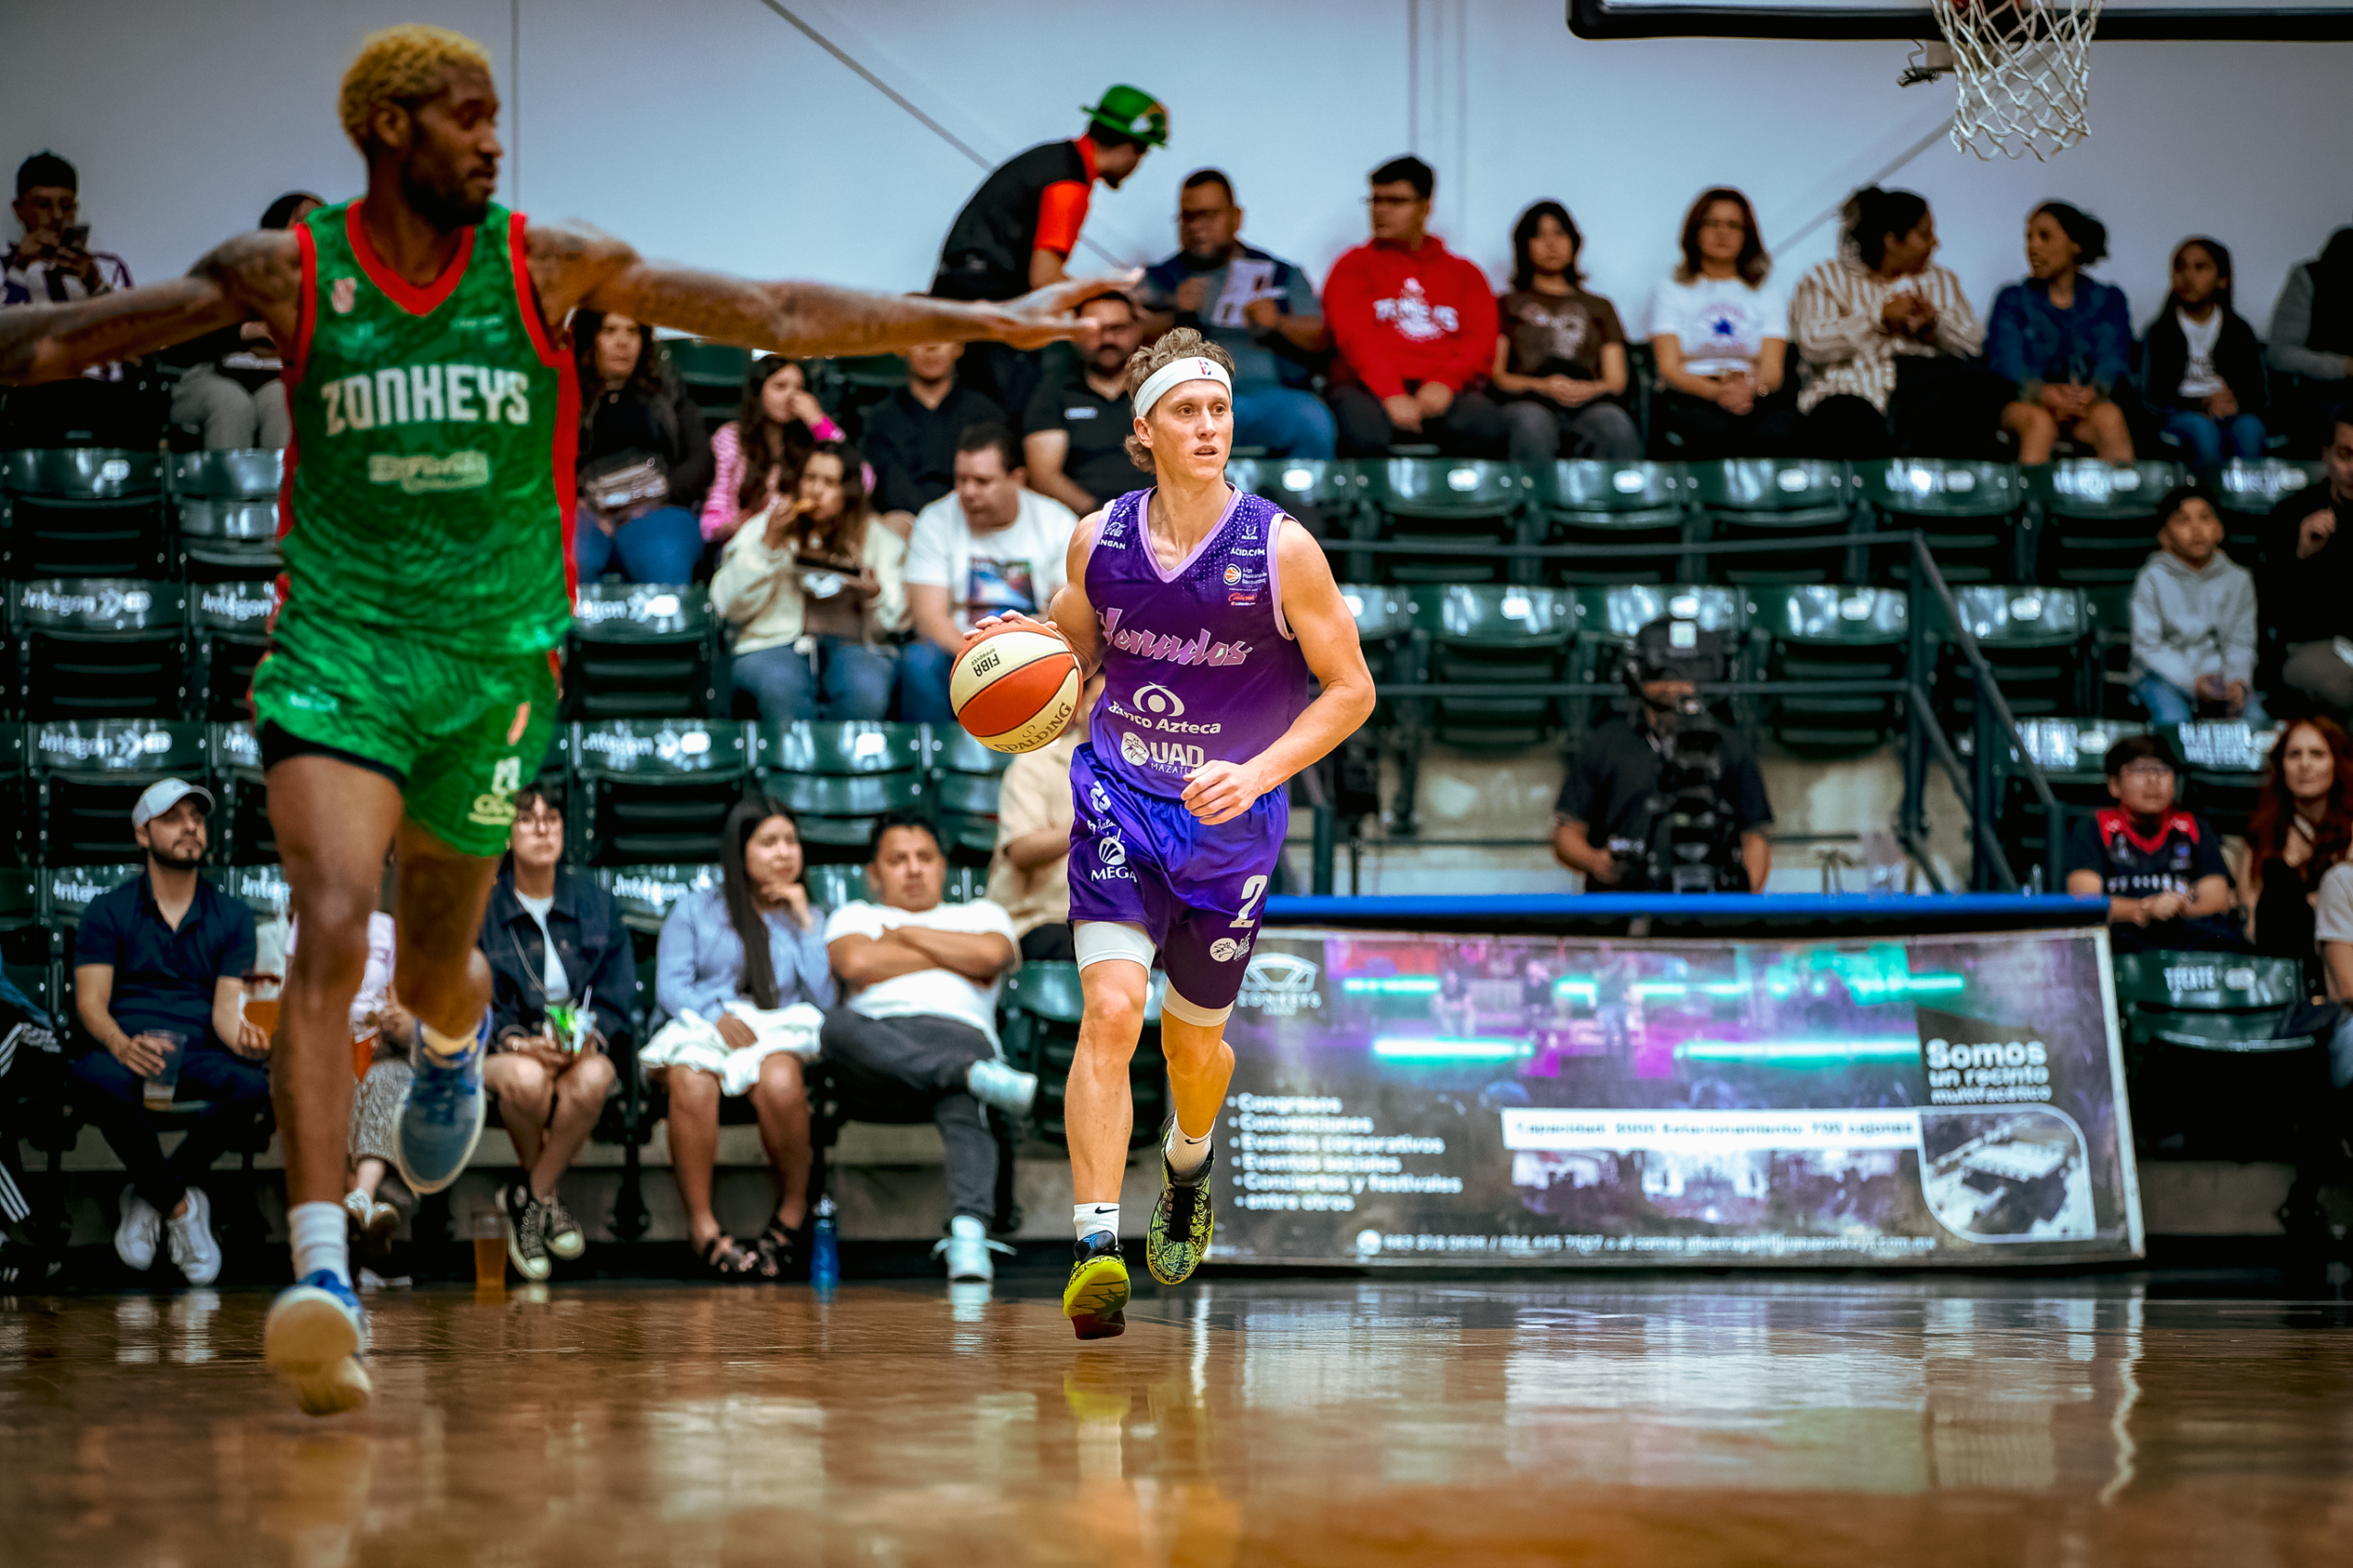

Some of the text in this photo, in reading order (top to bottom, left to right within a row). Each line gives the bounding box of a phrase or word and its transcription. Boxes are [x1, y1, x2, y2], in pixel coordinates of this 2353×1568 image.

[321, 364, 529, 437] ZONKEYS
[973, 653, 1000, 677] FIBA
[1155, 719, 1222, 734] Azteca
[1150, 742, 1204, 768] UAD
[1151, 763, 1196, 775] MAZATL
[1091, 866, 1138, 882] MEGA
[1926, 1038, 2048, 1070] Somos
[1928, 1064, 2050, 1088] un recinto
[1238, 1092, 1343, 1115] Congresos
[1240, 1131, 1320, 1153] Eventos
[1242, 1152, 1321, 1172] Eventos
[1350, 1176, 1367, 1195] y
